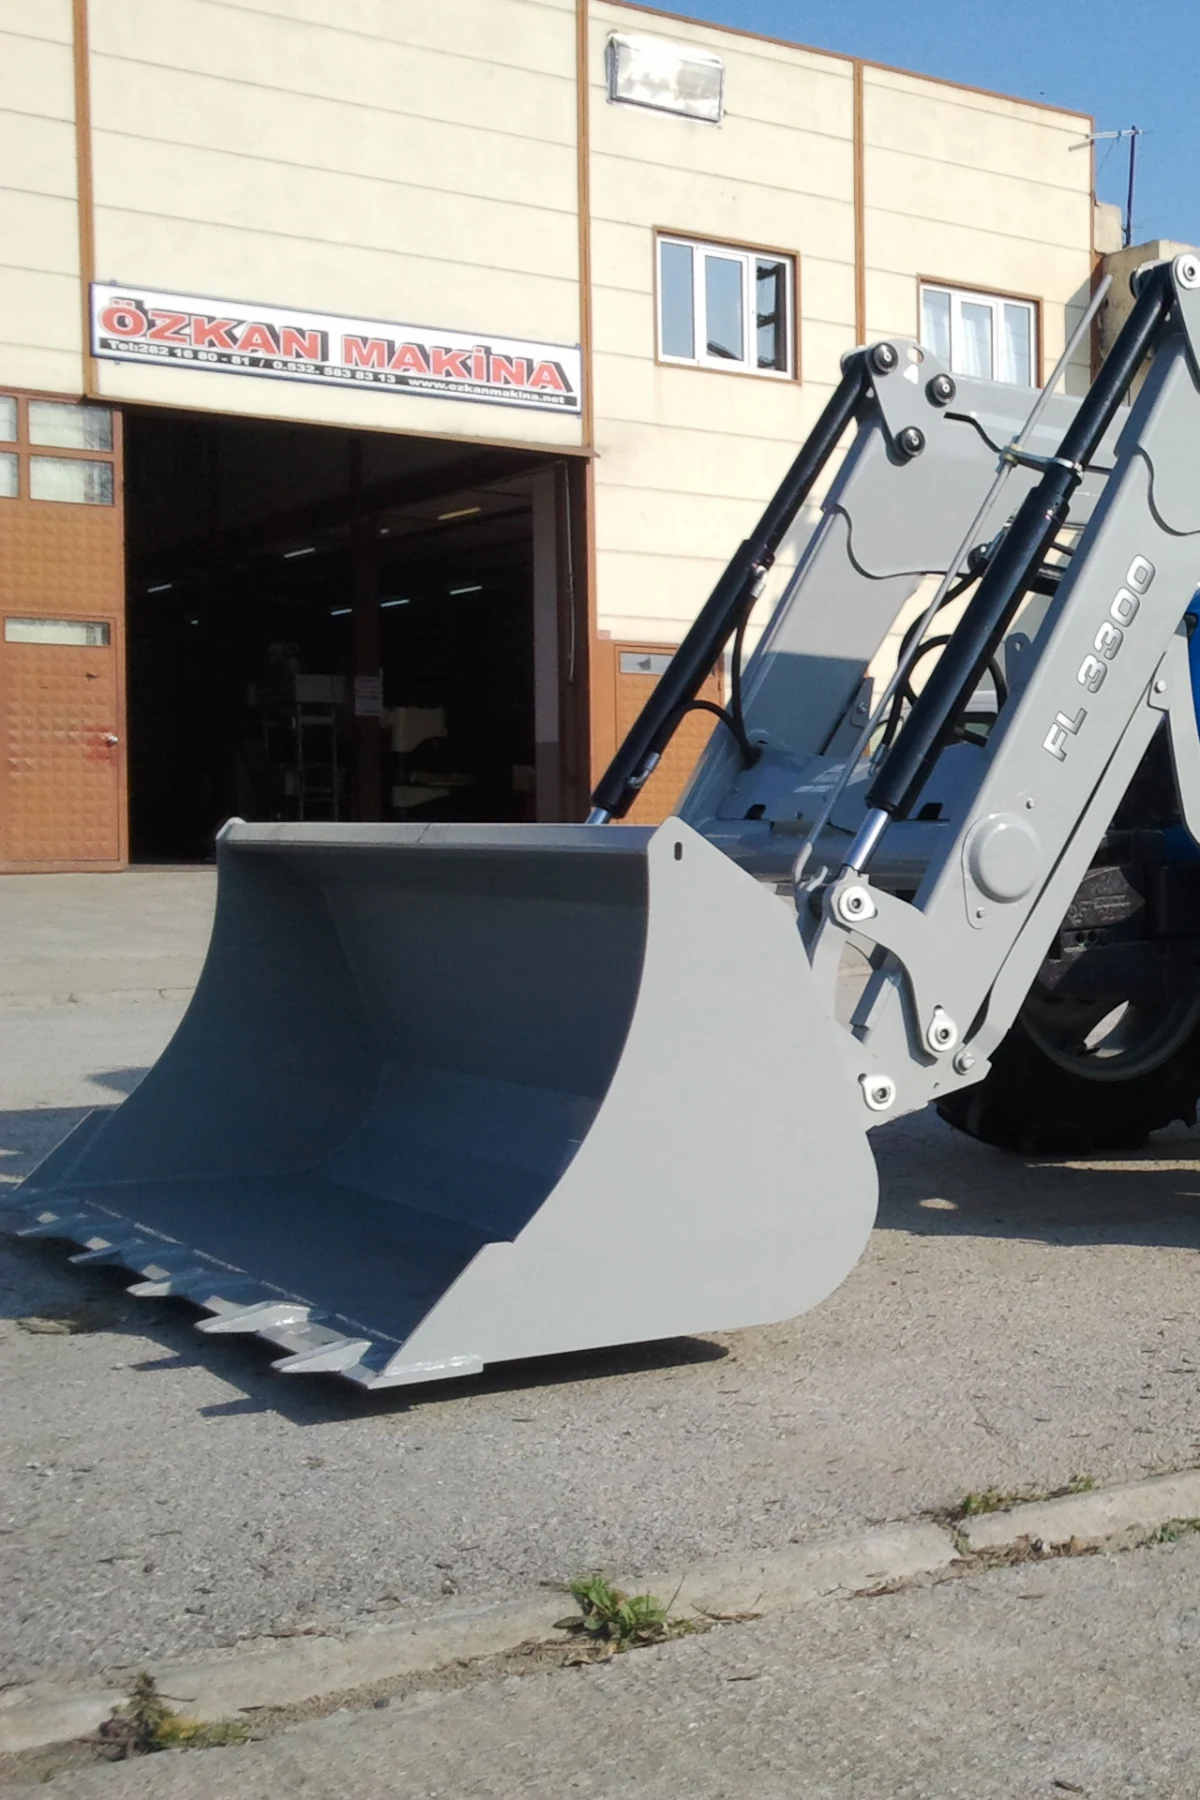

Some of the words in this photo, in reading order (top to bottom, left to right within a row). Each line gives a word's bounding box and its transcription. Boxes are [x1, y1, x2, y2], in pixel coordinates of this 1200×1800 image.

[99, 297, 329, 362] ÖZKAN
[341, 334, 573, 392] MAKİNA
[197, 350, 218, 362] 80
[231, 355, 250, 366] 81
[1042, 707, 1088, 762] FL
[1077, 554, 1156, 693] 3300
